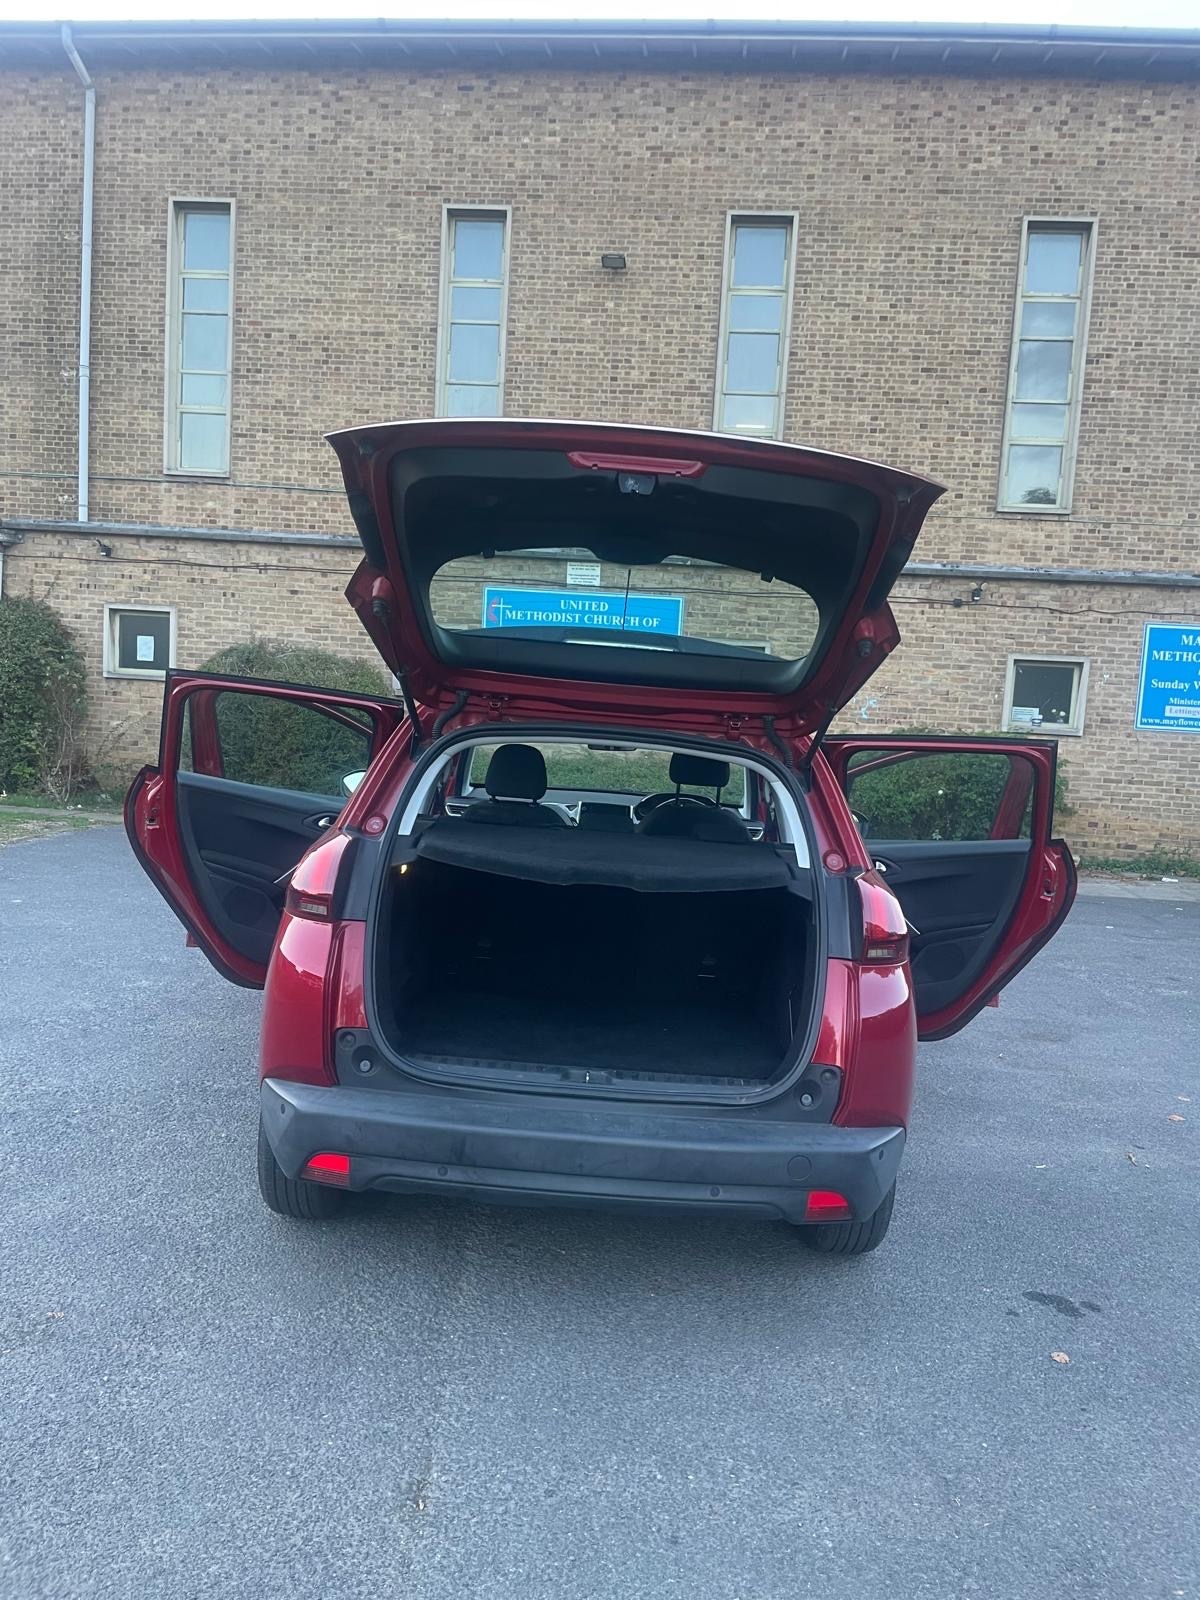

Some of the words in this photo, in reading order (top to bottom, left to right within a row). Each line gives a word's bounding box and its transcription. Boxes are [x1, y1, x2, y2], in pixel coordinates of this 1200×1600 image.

[561, 600, 609, 612] UNITED
[506, 610, 582, 624] METHODIST
[584, 614, 639, 625] CHURCH
[643, 617, 661, 628] OF
[1151, 679, 1190, 692] Sunday
